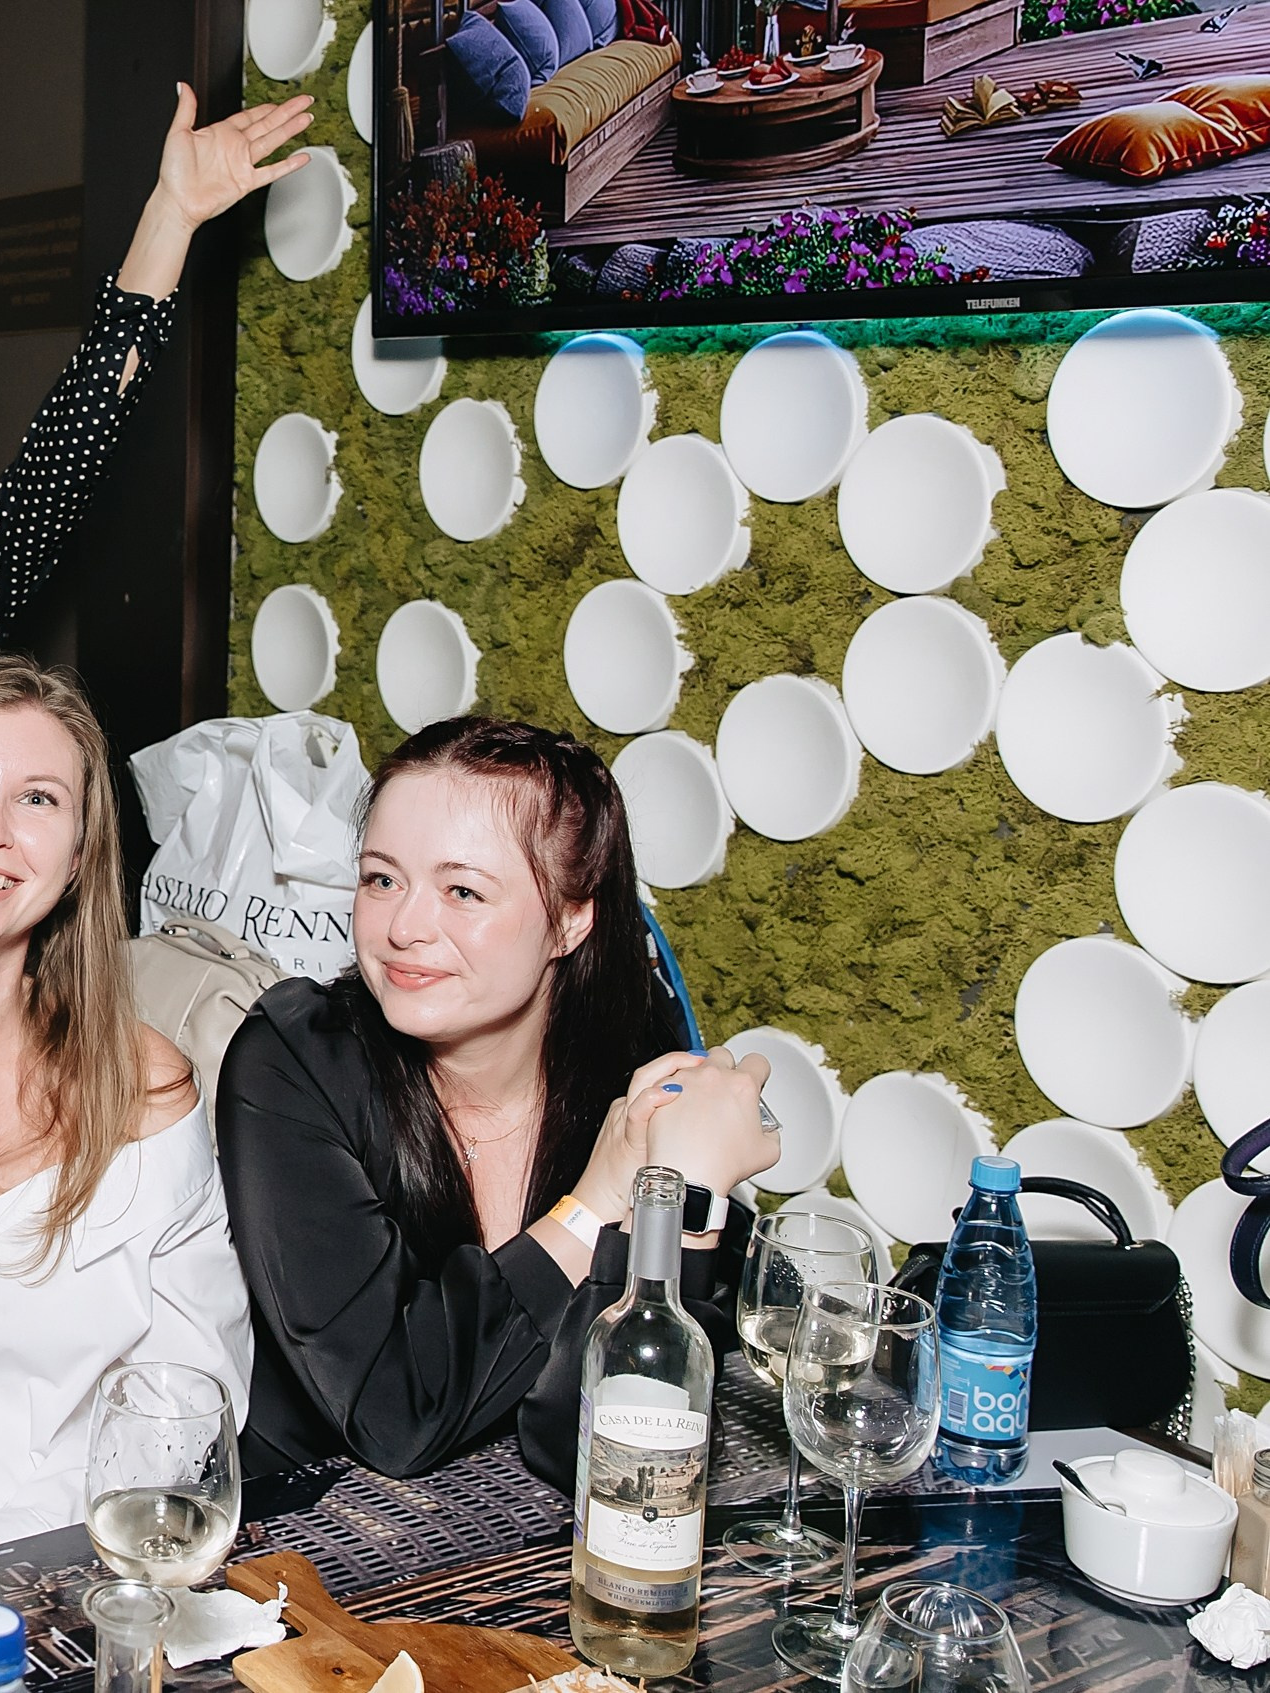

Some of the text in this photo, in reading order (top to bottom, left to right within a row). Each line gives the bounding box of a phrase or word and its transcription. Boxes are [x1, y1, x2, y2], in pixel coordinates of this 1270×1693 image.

[966, 297, 1020, 309] TELEFUNKEN
[599, 1414, 630, 1426] CASA
[634, 1415, 653, 1426] DE
[656, 1417, 673, 1428] LA
[598, 1577, 635, 1593] BLANCO
[607, 1592, 632, 1603] WHITE
